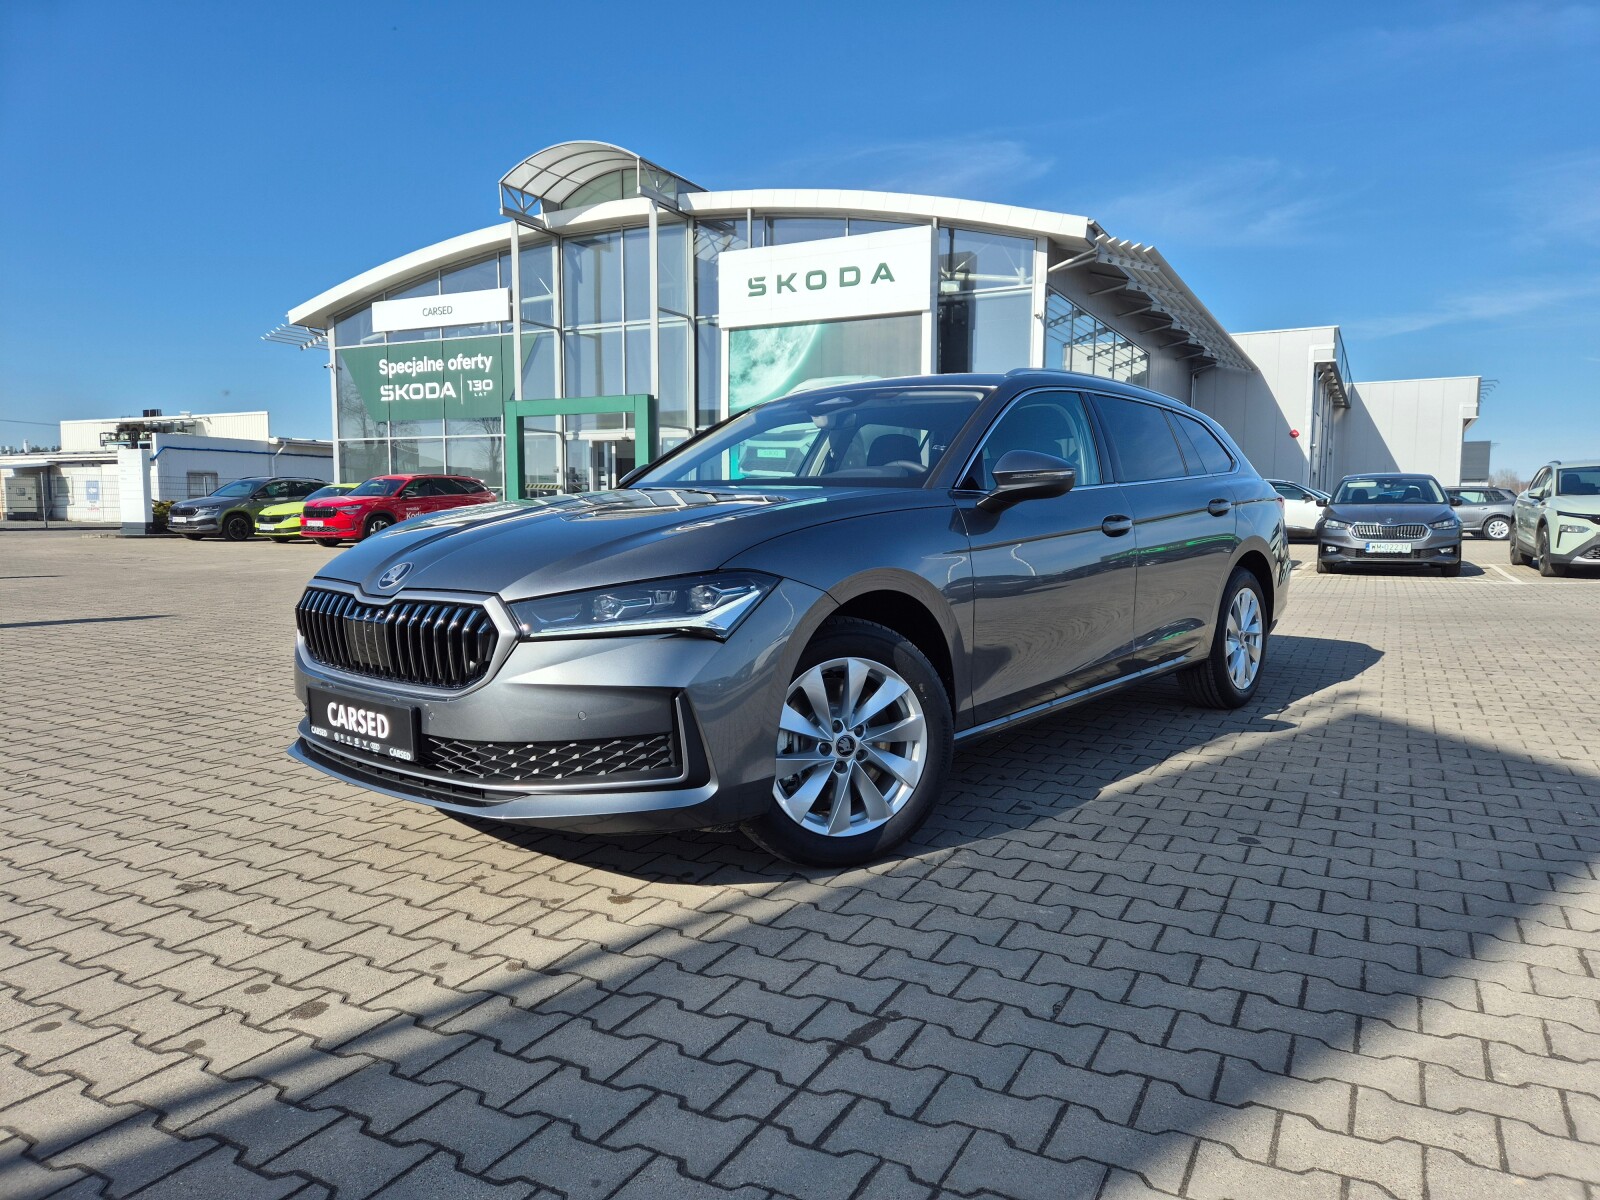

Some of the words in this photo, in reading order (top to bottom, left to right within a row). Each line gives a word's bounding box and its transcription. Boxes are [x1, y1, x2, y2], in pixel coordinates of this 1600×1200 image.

[422, 306, 453, 316] CARSED
[379, 355, 445, 378] Specjalne
[447, 353, 493, 373] oferty
[467, 379, 493, 391] 130
[327, 702, 389, 738] CARSED
[311, 726, 327, 737] CARSED
[389, 747, 411, 760] CARSED
